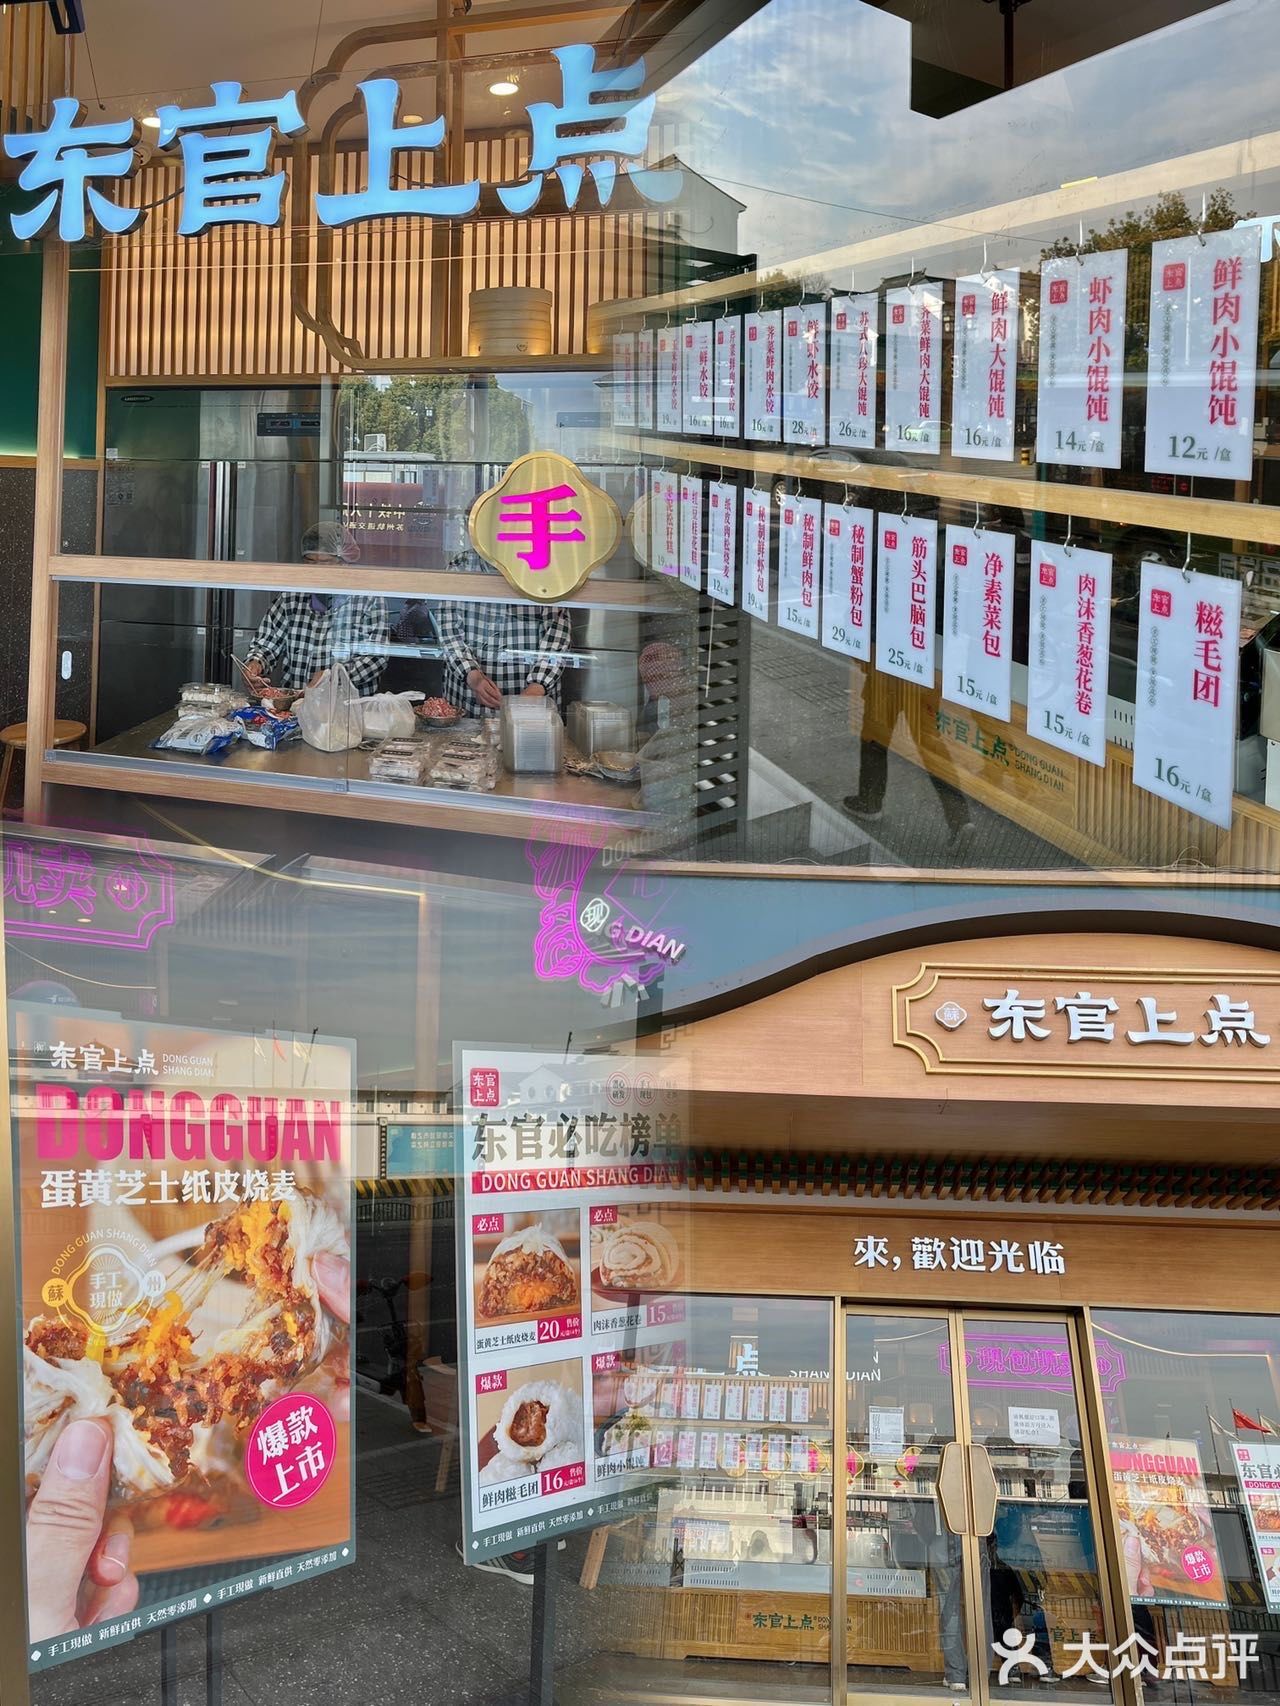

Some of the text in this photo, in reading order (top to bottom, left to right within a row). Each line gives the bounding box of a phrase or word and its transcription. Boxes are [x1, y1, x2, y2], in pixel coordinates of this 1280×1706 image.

[3, 43, 684, 242] 东官上点
[807, 320, 819, 400] 鲜虾水饺
[988, 292, 1009, 420] 鲜肉大馄饨
[1086, 276, 1113, 423] 虾肉小馄饨
[1208, 257, 1243, 426] 鲜肉小馄饨
[919, 304, 931, 419] 荠菜鲜肉大馄饨
[496, 484, 586, 570] 手
[801, 513, 815, 608] 秘制鲜肉包
[849, 524, 865, 628] 秘制蟹粉包
[909, 536, 928, 651] 筋头巴脑包
[982, 552, 1004, 658] 净素菜包
[1075, 573, 1097, 716] 肉沫香葱花卷
[1191, 601, 1225, 708] 糍毛团
[625, 925, 686, 963] DIAN
[981, 988, 1272, 1048] 东官上点
[49, 1040, 160, 1076] 东官上点
[162, 1053, 214, 1067] DONG GUAN
[162, 1065, 215, 1078] SHANG DIAN
[472, 1073, 497, 1087] 东官
[472, 1088, 497, 1103] 上点
[35, 1083, 342, 1162] DONGGUAN
[471, 1113, 682, 1164] 东官必吃榜单
[40, 1169, 297, 1209] 蛋黄芝士纸皮烧麦
[482, 1172, 531, 1192] DONG
[536, 1169, 581, 1189] GUAN
[586, 1167, 639, 1187] SHANG
[476, 1216, 500, 1232] 必点
[593, 1209, 614, 1223] 必点
[51, 1243, 77, 1275] DONG
[75, 1230, 104, 1248] GUAN
[89, 1271, 122, 1290] 手工
[476, 1319, 560, 1350] 蛋黄芝士纸皮烧麦 20
[592, 1315, 642, 1332] 肉沫香葱花卷
[648, 1304, 666, 1322] 15
[595, 1355, 616, 1371] 爆款
[480, 1375, 504, 1391] 爆款
[256, 1405, 319, 1466] 爆款
[271, 1441, 326, 1503] 上市
[543, 1470, 564, 1493] 16
[1249, 1481, 1270, 1489] DONG
[297, 1550, 338, 1574] 天然零添加
[1184, 1550, 1207, 1565] 爆款
[1191, 1564, 1211, 1579] 上市
[147, 1597, 198, 1625] 天然零添加
[752, 1612, 815, 1631] 东官上点
